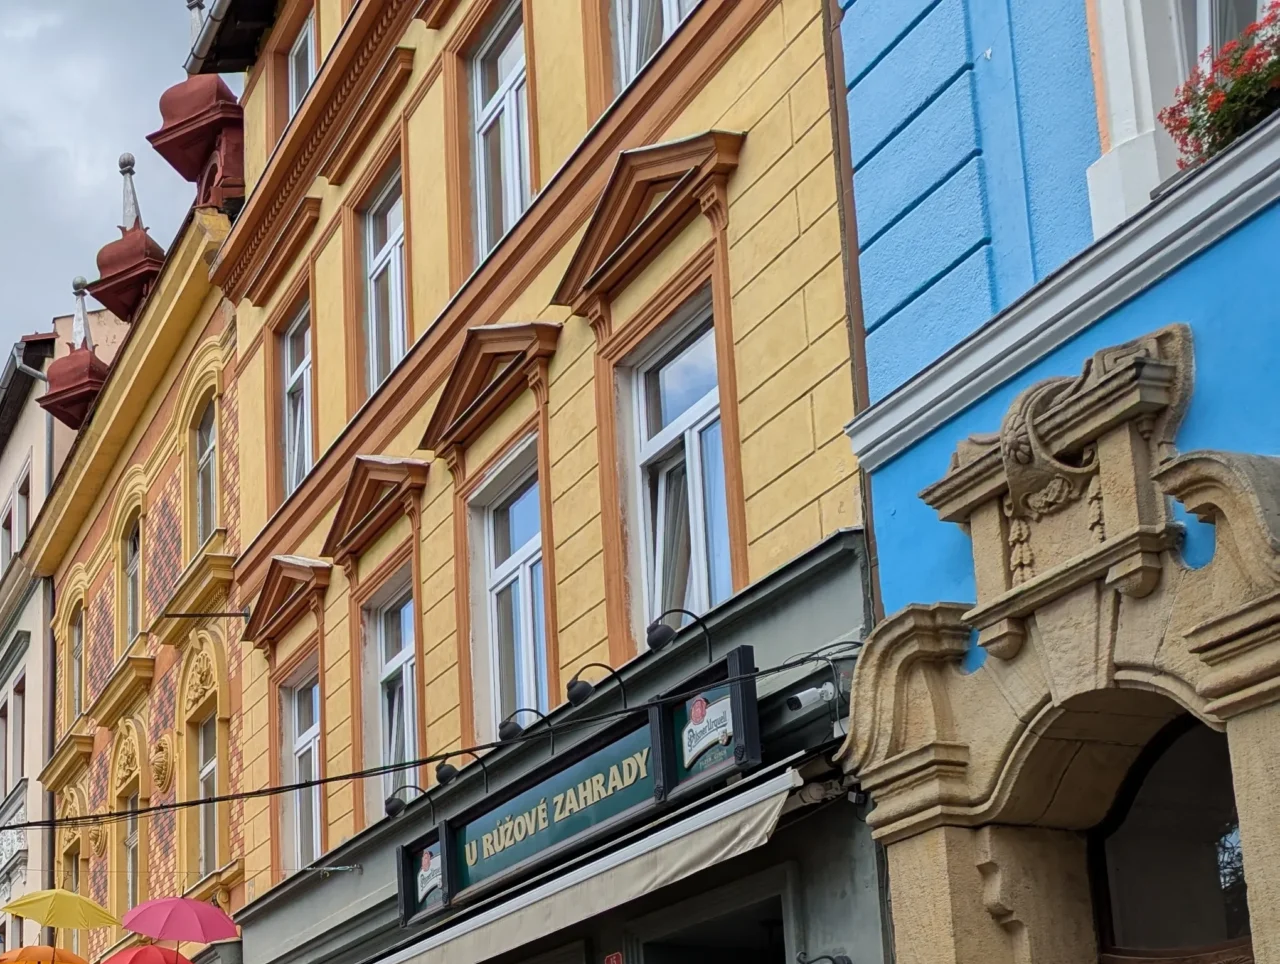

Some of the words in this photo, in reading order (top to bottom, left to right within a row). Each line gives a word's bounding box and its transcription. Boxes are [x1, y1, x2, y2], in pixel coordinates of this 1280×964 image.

[687, 727, 709, 753] Pilsner
[464, 839, 478, 867] U
[482, 797, 549, 860] RŮŽOVÉ
[553, 747, 651, 823] ZAHRADY
